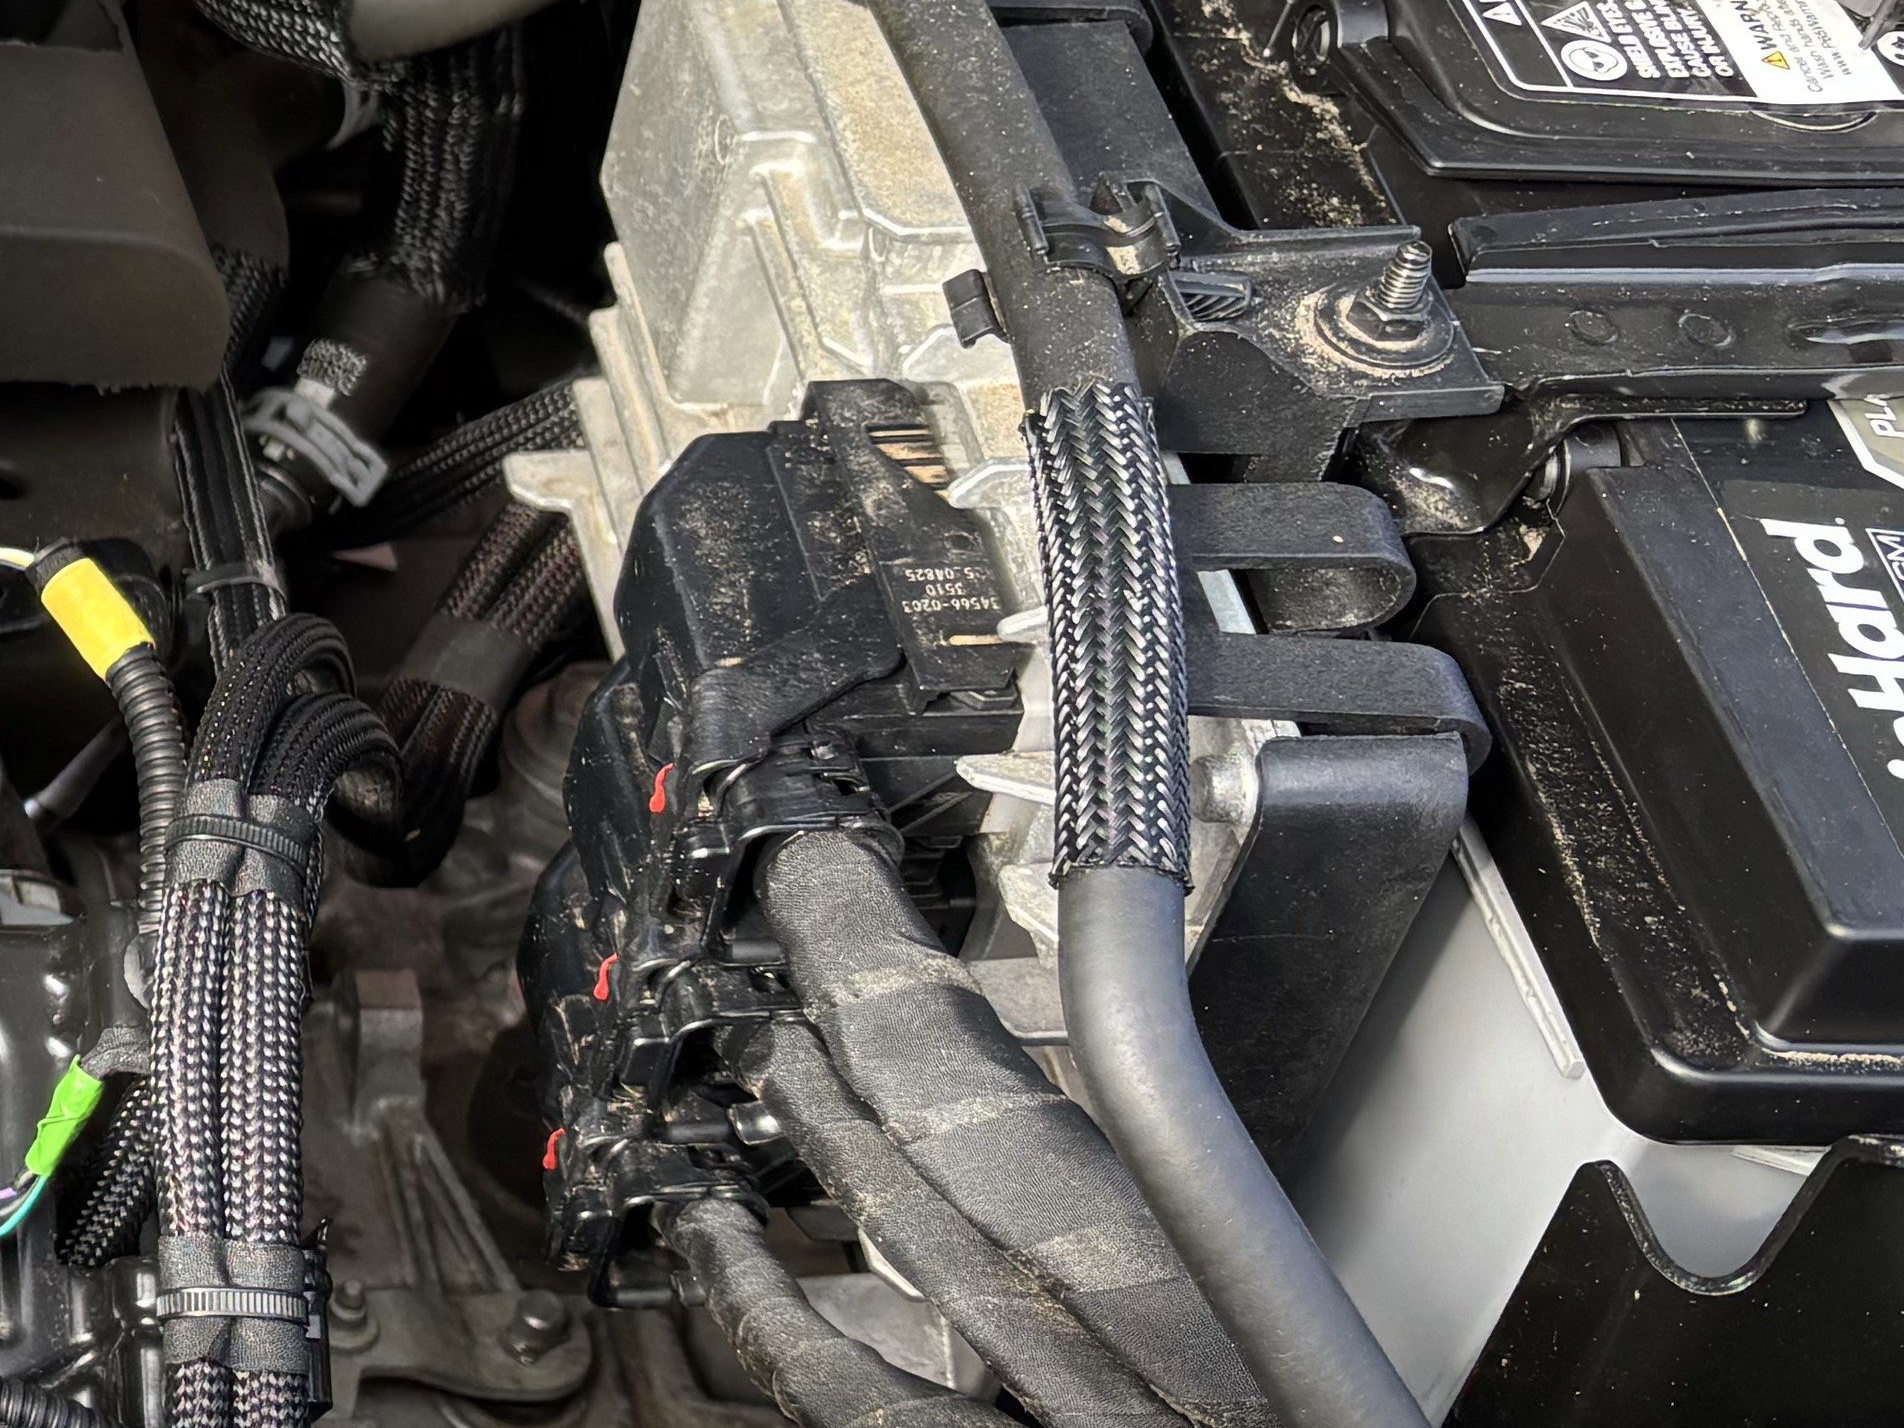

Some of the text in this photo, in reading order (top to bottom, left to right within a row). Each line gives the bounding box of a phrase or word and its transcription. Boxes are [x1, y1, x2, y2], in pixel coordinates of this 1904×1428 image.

[1628, 11, 1690, 77] EXPLOSIVE
[1667, 32, 1714, 76] CAUSE
[1705, 55, 1736, 76] OR
